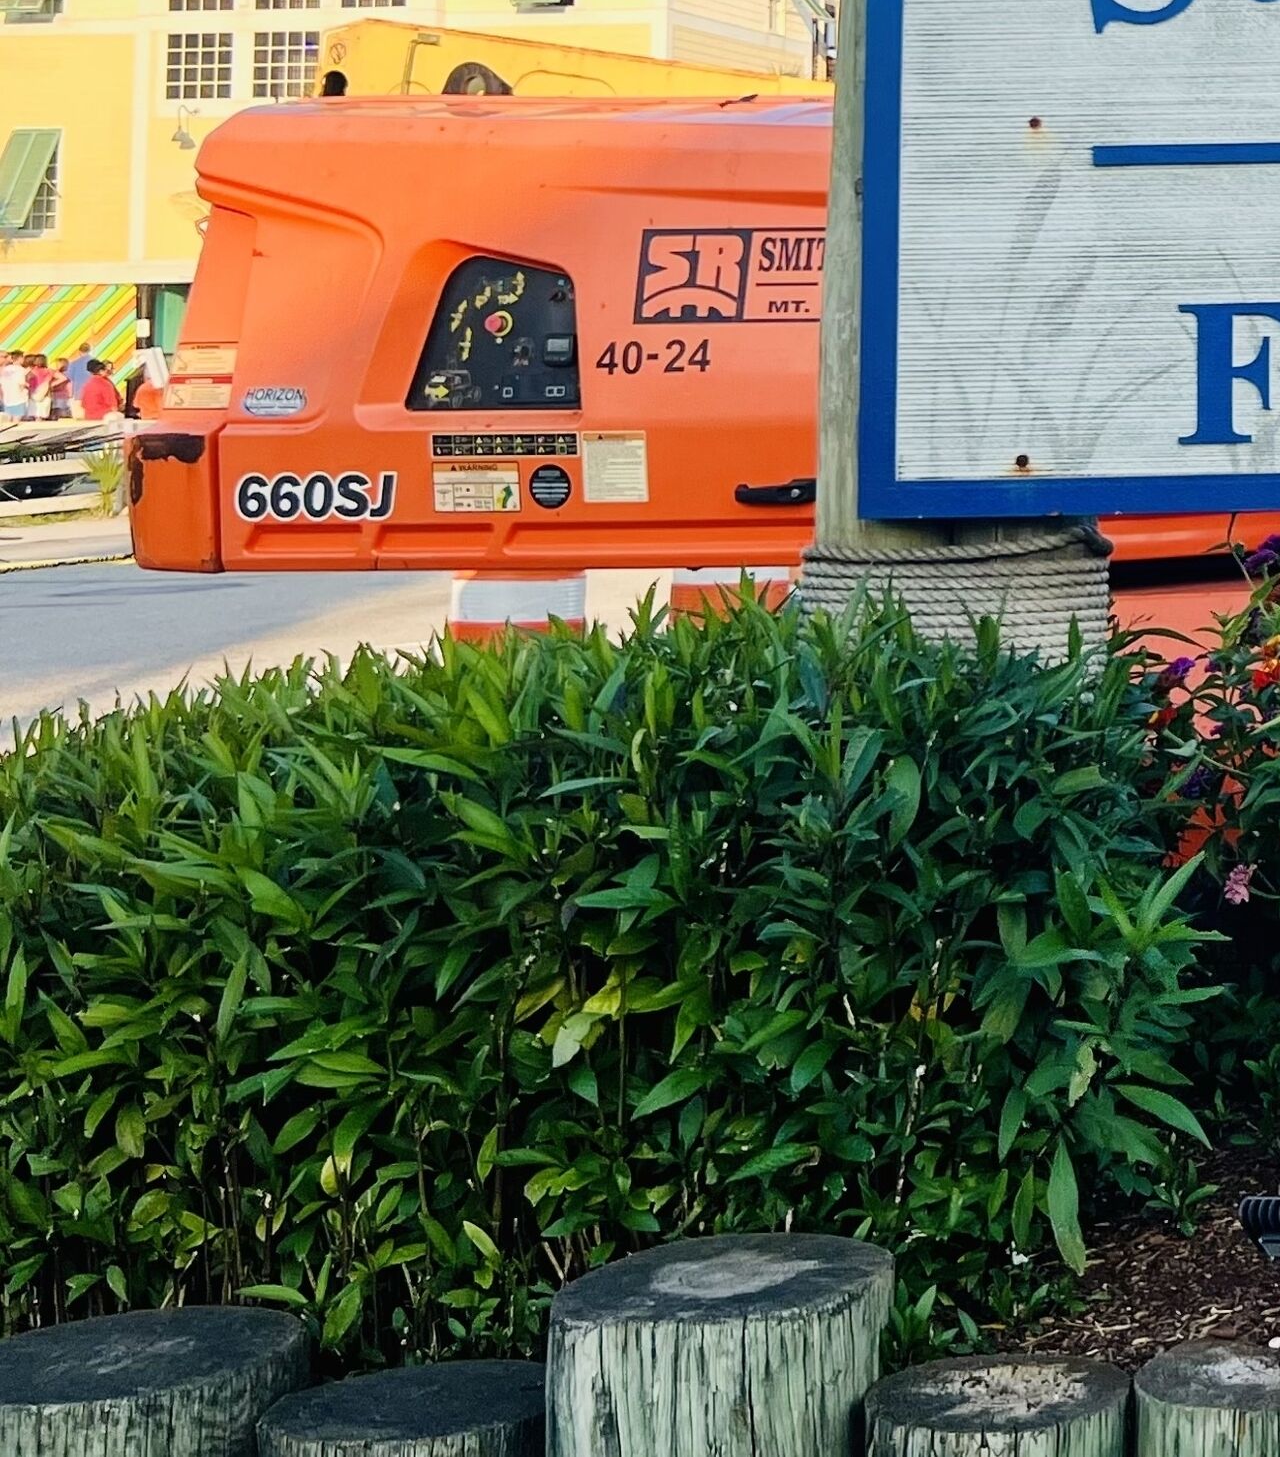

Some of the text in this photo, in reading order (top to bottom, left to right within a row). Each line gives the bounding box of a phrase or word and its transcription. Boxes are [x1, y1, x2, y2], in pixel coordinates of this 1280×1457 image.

[767, 300, 810, 313] MT.
[595, 338, 711, 375] 40-24
[246, 388, 306, 401] HORIZON
[237, 473, 395, 520] 660SJ
